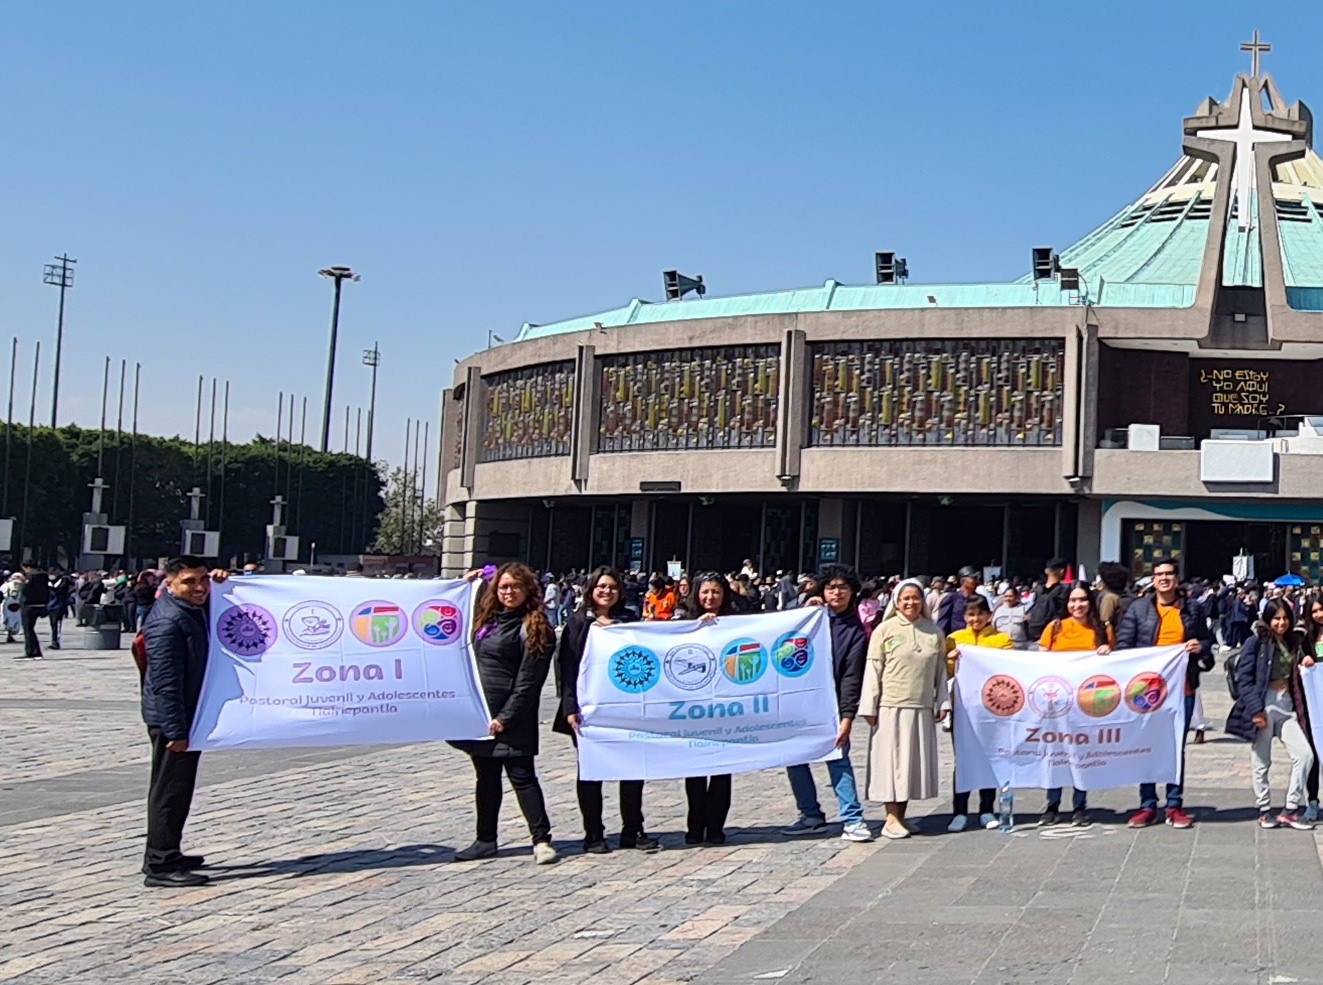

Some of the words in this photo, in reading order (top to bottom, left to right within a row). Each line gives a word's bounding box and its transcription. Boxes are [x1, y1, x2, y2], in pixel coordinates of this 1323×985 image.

[1212, 381, 1233, 391] YO
[1236, 381, 1268, 393] AQUI
[1212, 393, 1238, 403] QUE
[1240, 392, 1269, 404] SOY
[1211, 403, 1225, 414] TU
[292, 662, 384, 684] Zona
[395, 658, 403, 680] I
[357, 693, 365, 703] y
[368, 690, 456, 702] Adolescentes
[668, 701, 745, 720] Zona
[753, 695, 770, 714] II
[1025, 728, 1090, 745] Zona
[1098, 727, 1121, 744] III
